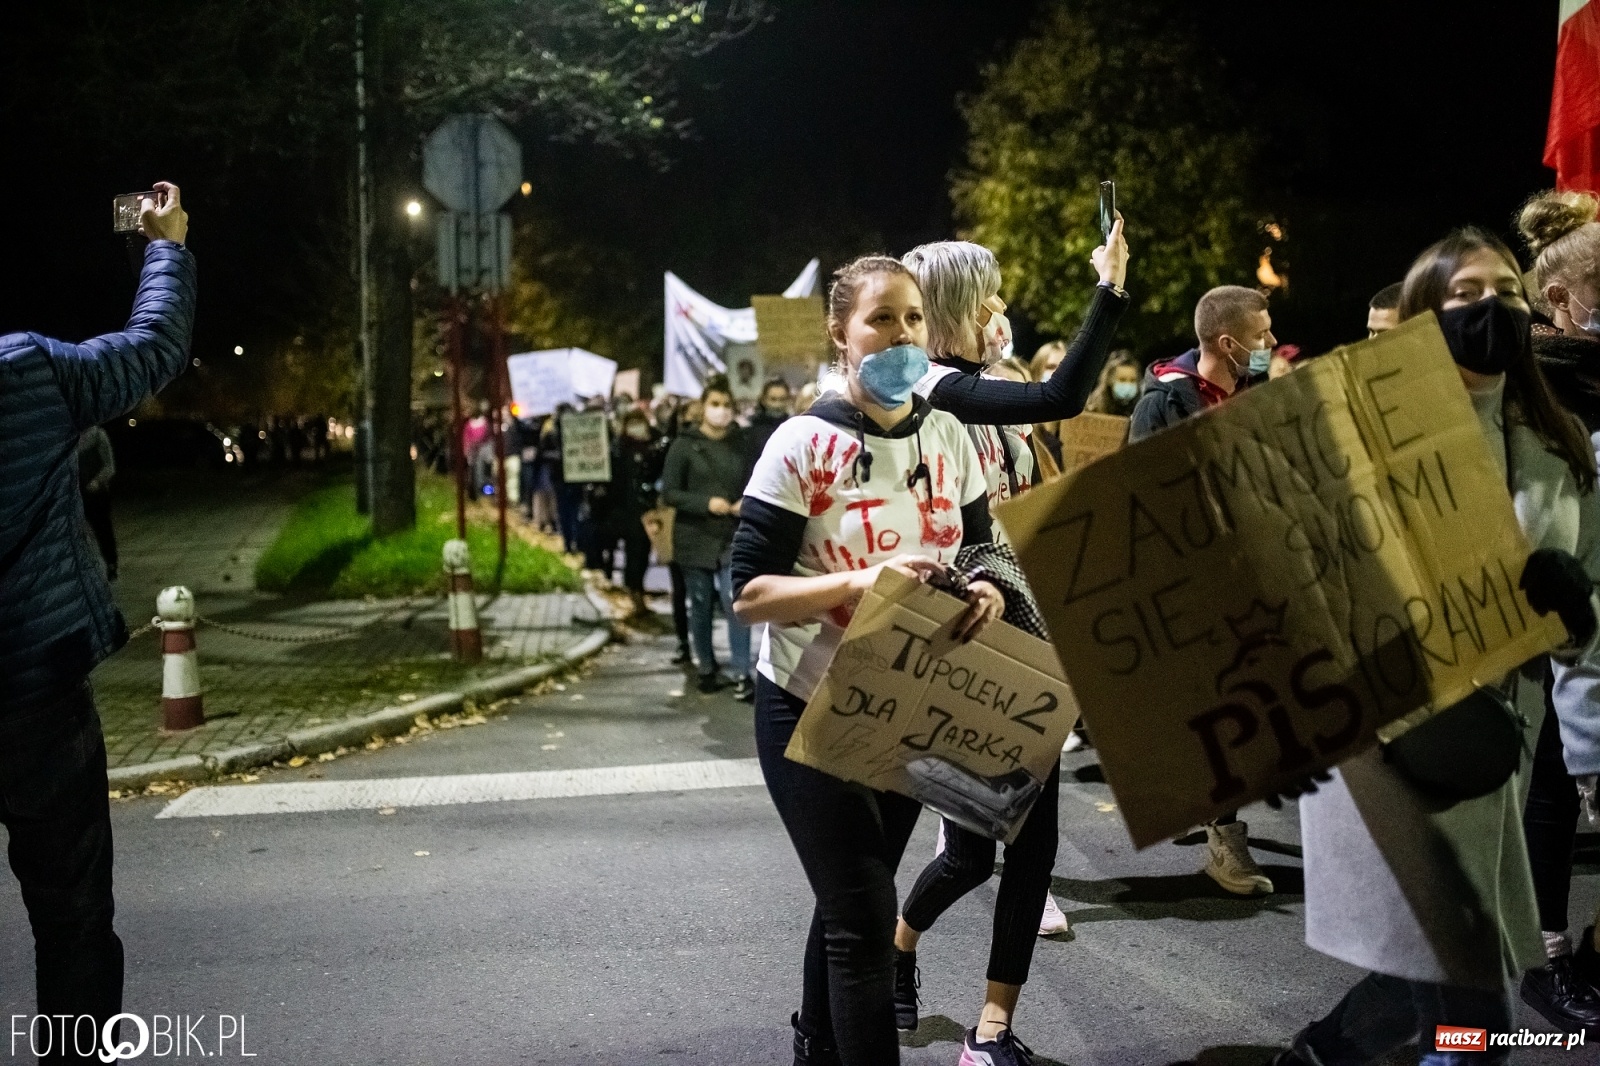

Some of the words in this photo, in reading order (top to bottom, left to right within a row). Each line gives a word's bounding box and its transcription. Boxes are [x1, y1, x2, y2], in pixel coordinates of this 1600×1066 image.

[1037, 366, 1424, 606] ZAJMIJCIE
[830, 685, 898, 723] DLA
[901, 705, 1024, 768] JARKA
[1010, 691, 1059, 735] 2
